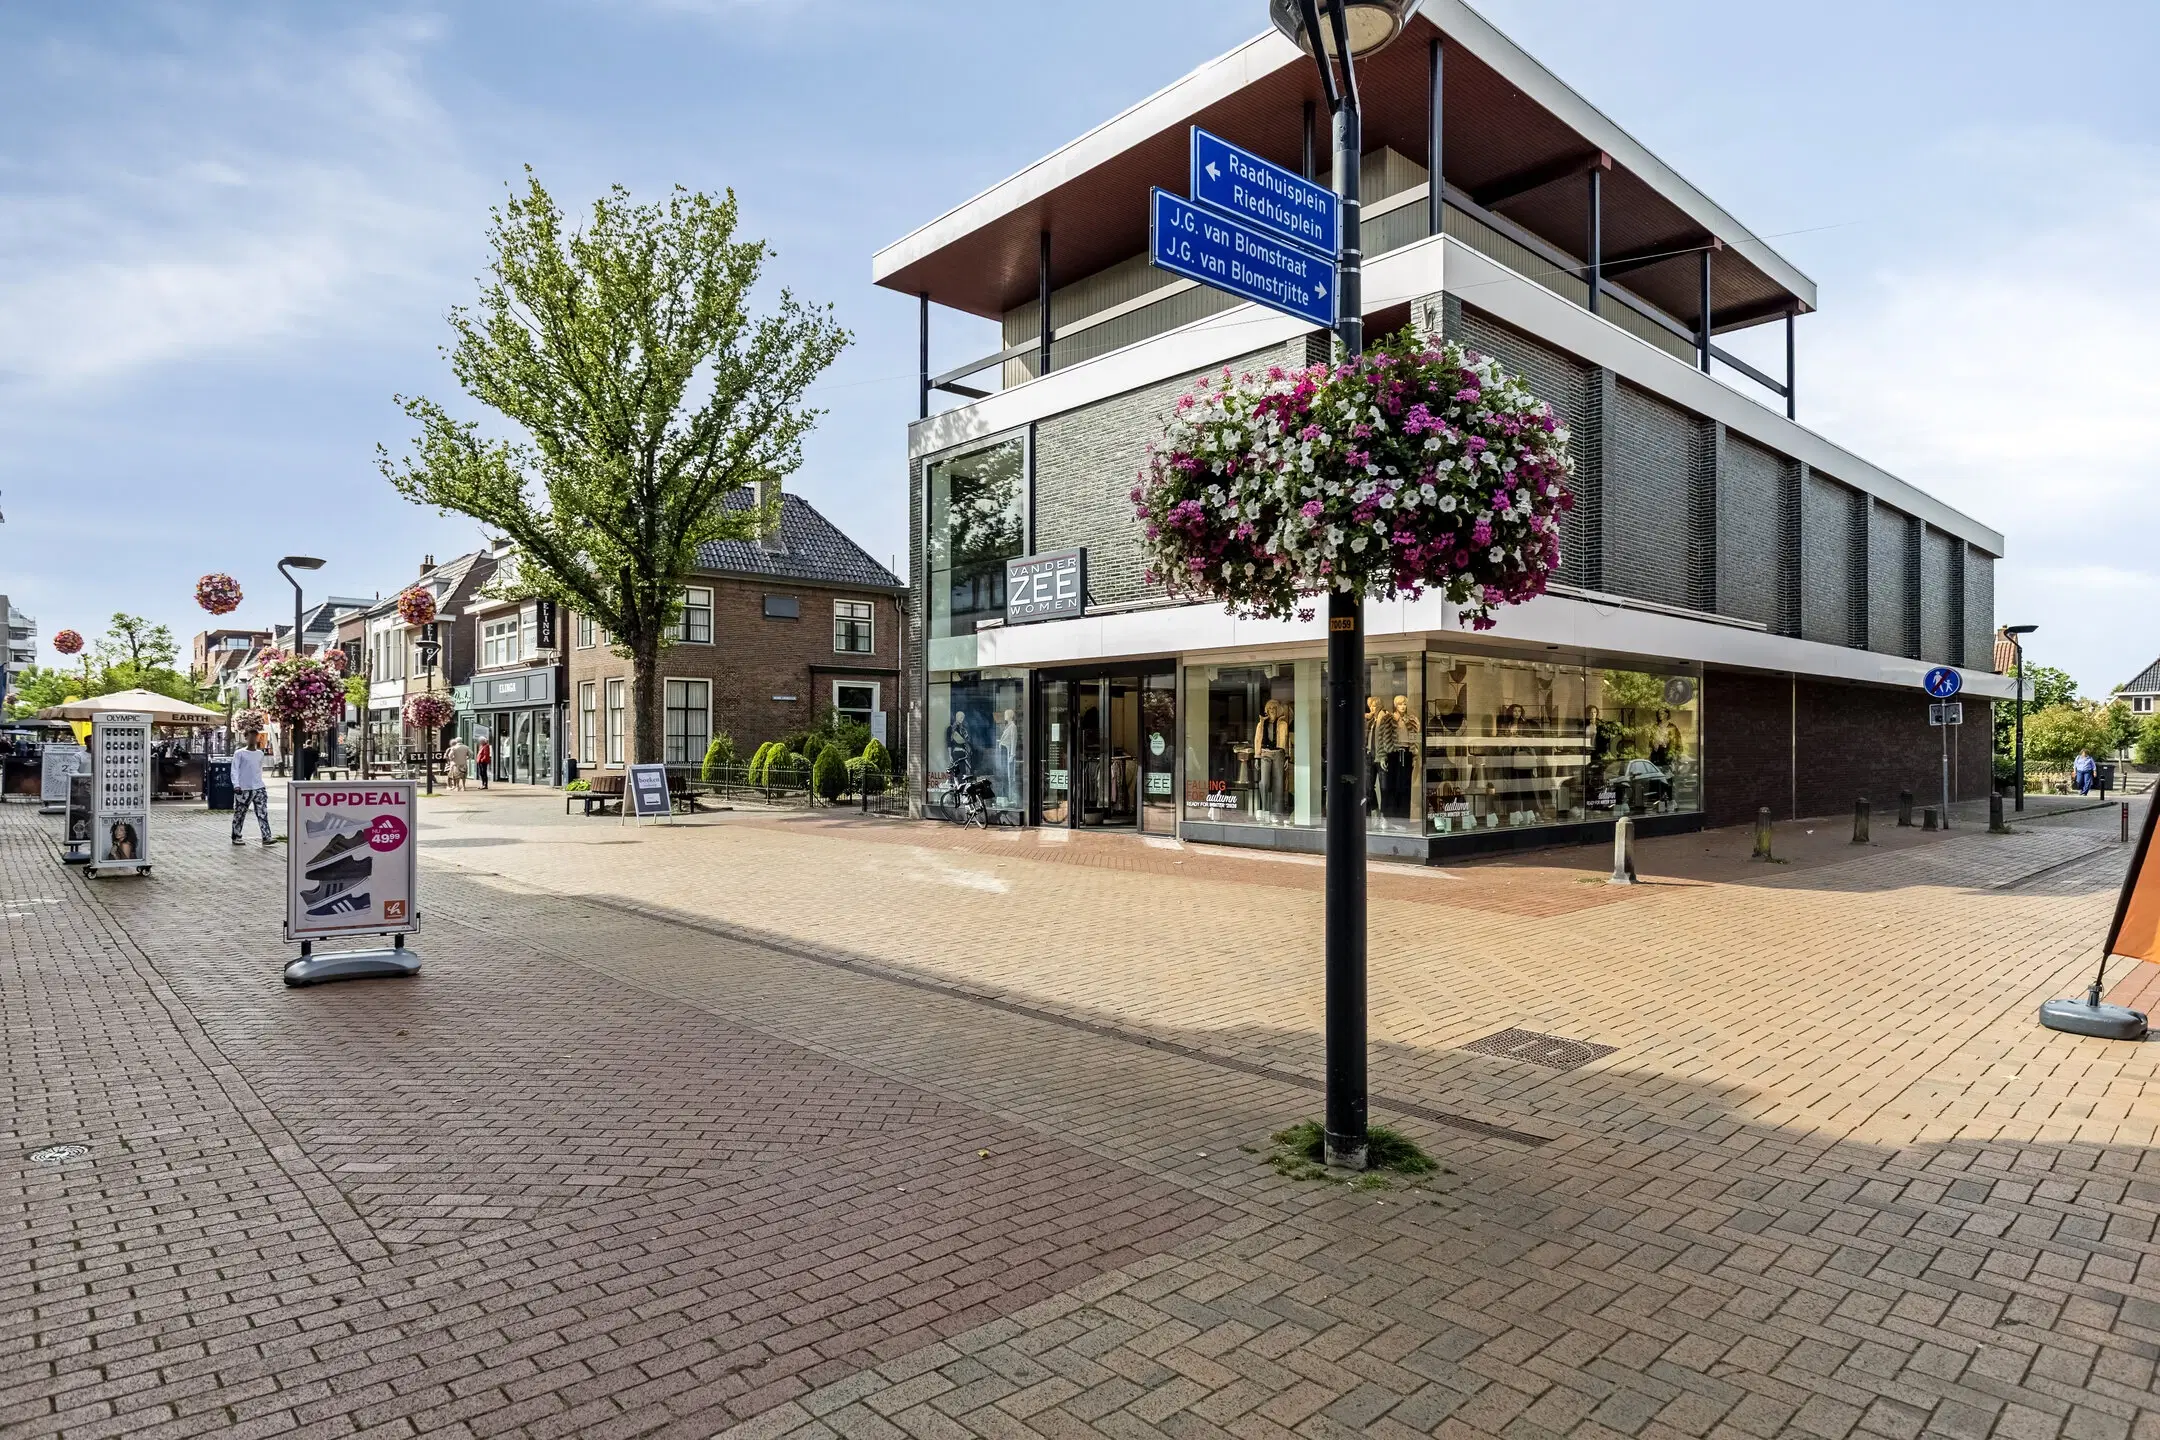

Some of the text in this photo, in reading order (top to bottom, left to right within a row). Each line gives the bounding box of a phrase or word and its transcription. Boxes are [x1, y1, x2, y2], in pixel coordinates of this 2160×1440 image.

[1229, 153, 1326, 215] Raadhuisplein
[1233, 184, 1323, 240] Riedhúsplein
[1170, 207, 1307, 279] J.G. van Blomstraat
[1166, 236, 1309, 307] J.G. van Blomstrjitte
[1010, 557, 1077, 577] VAN DER
[1010, 567, 1077, 606] ZEE
[1010, 598, 1077, 615] WOMEN
[426, 624, 434, 661] ELIGA
[106, 714, 141, 722] OLYMPIC
[1146, 777, 1170, 788] ZEE
[1186, 780, 1226, 791] FALLING
[301, 791, 406, 807] TOPDEAL
[1186, 790, 1205, 801] FOR
[1206, 790, 1238, 803] autumn
[371, 833, 401, 844] 49.99
